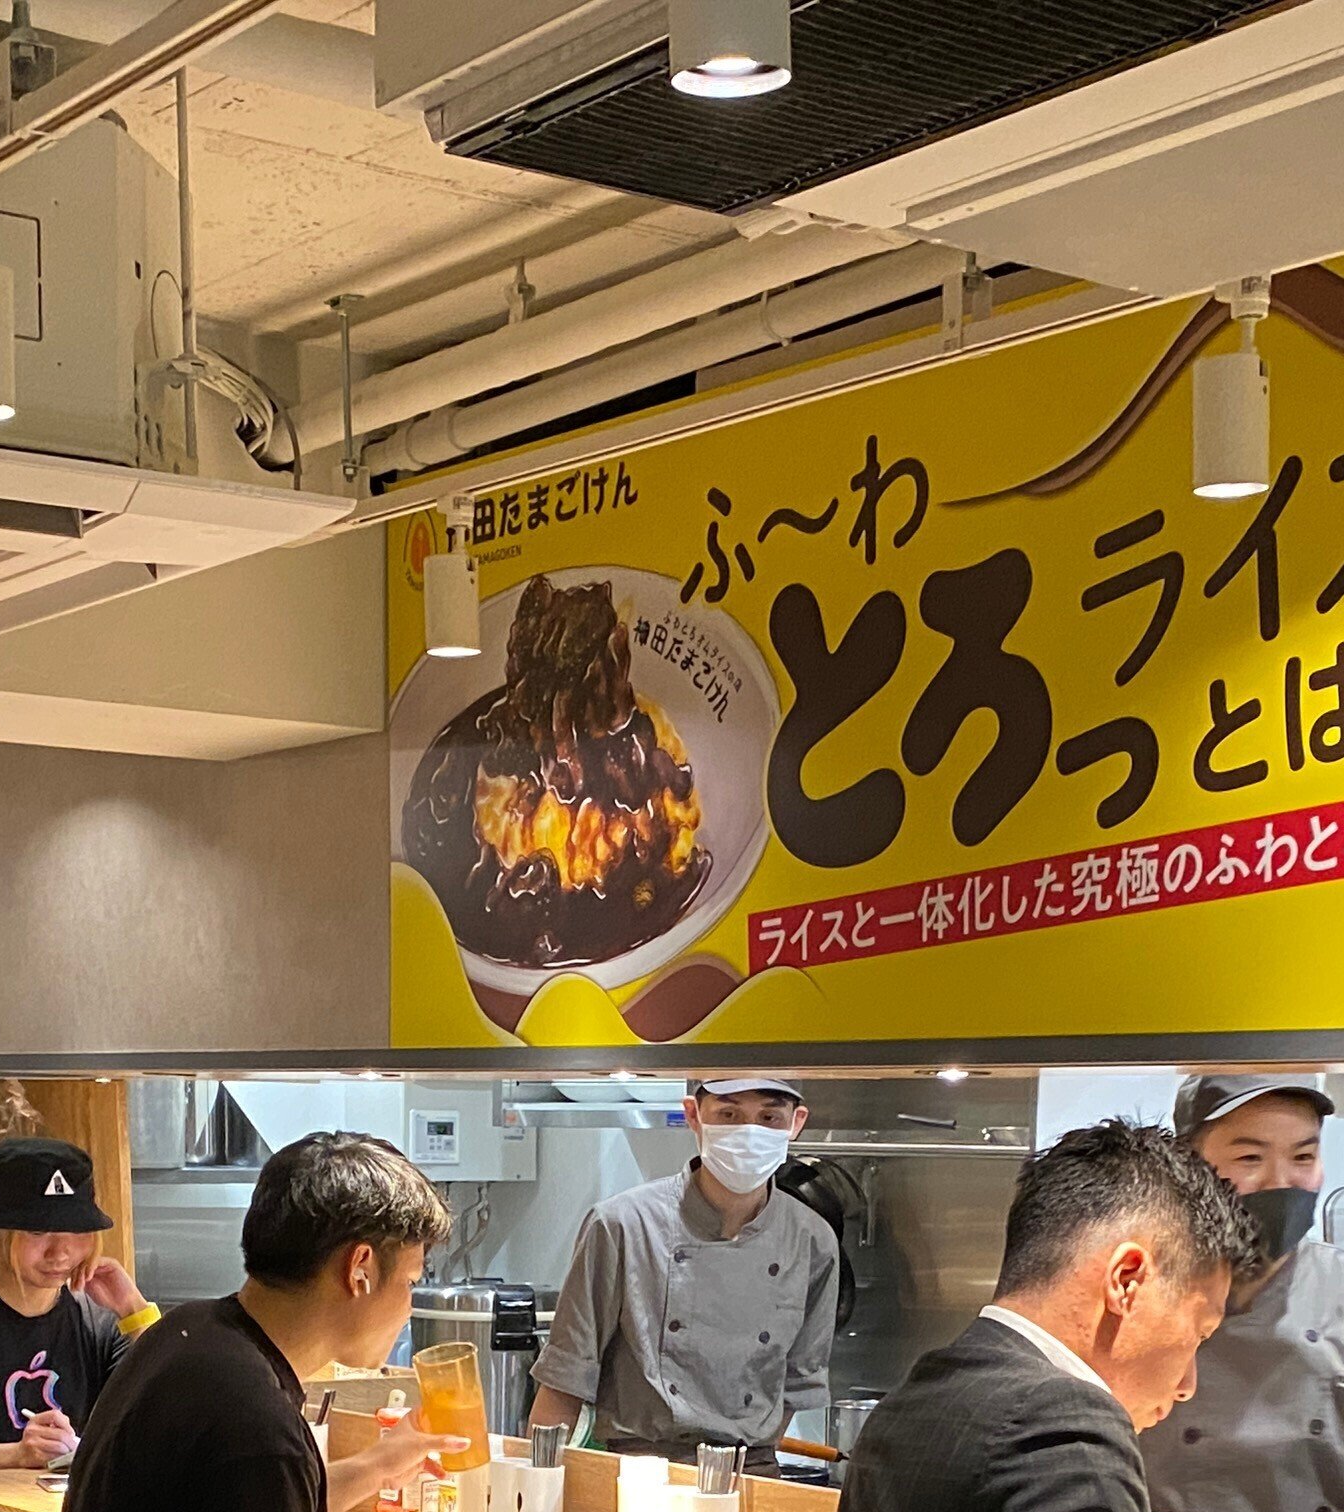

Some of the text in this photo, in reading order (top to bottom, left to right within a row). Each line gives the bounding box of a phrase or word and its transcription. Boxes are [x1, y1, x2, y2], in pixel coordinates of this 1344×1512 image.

[446, 462, 639, 553] 田たまごけん
